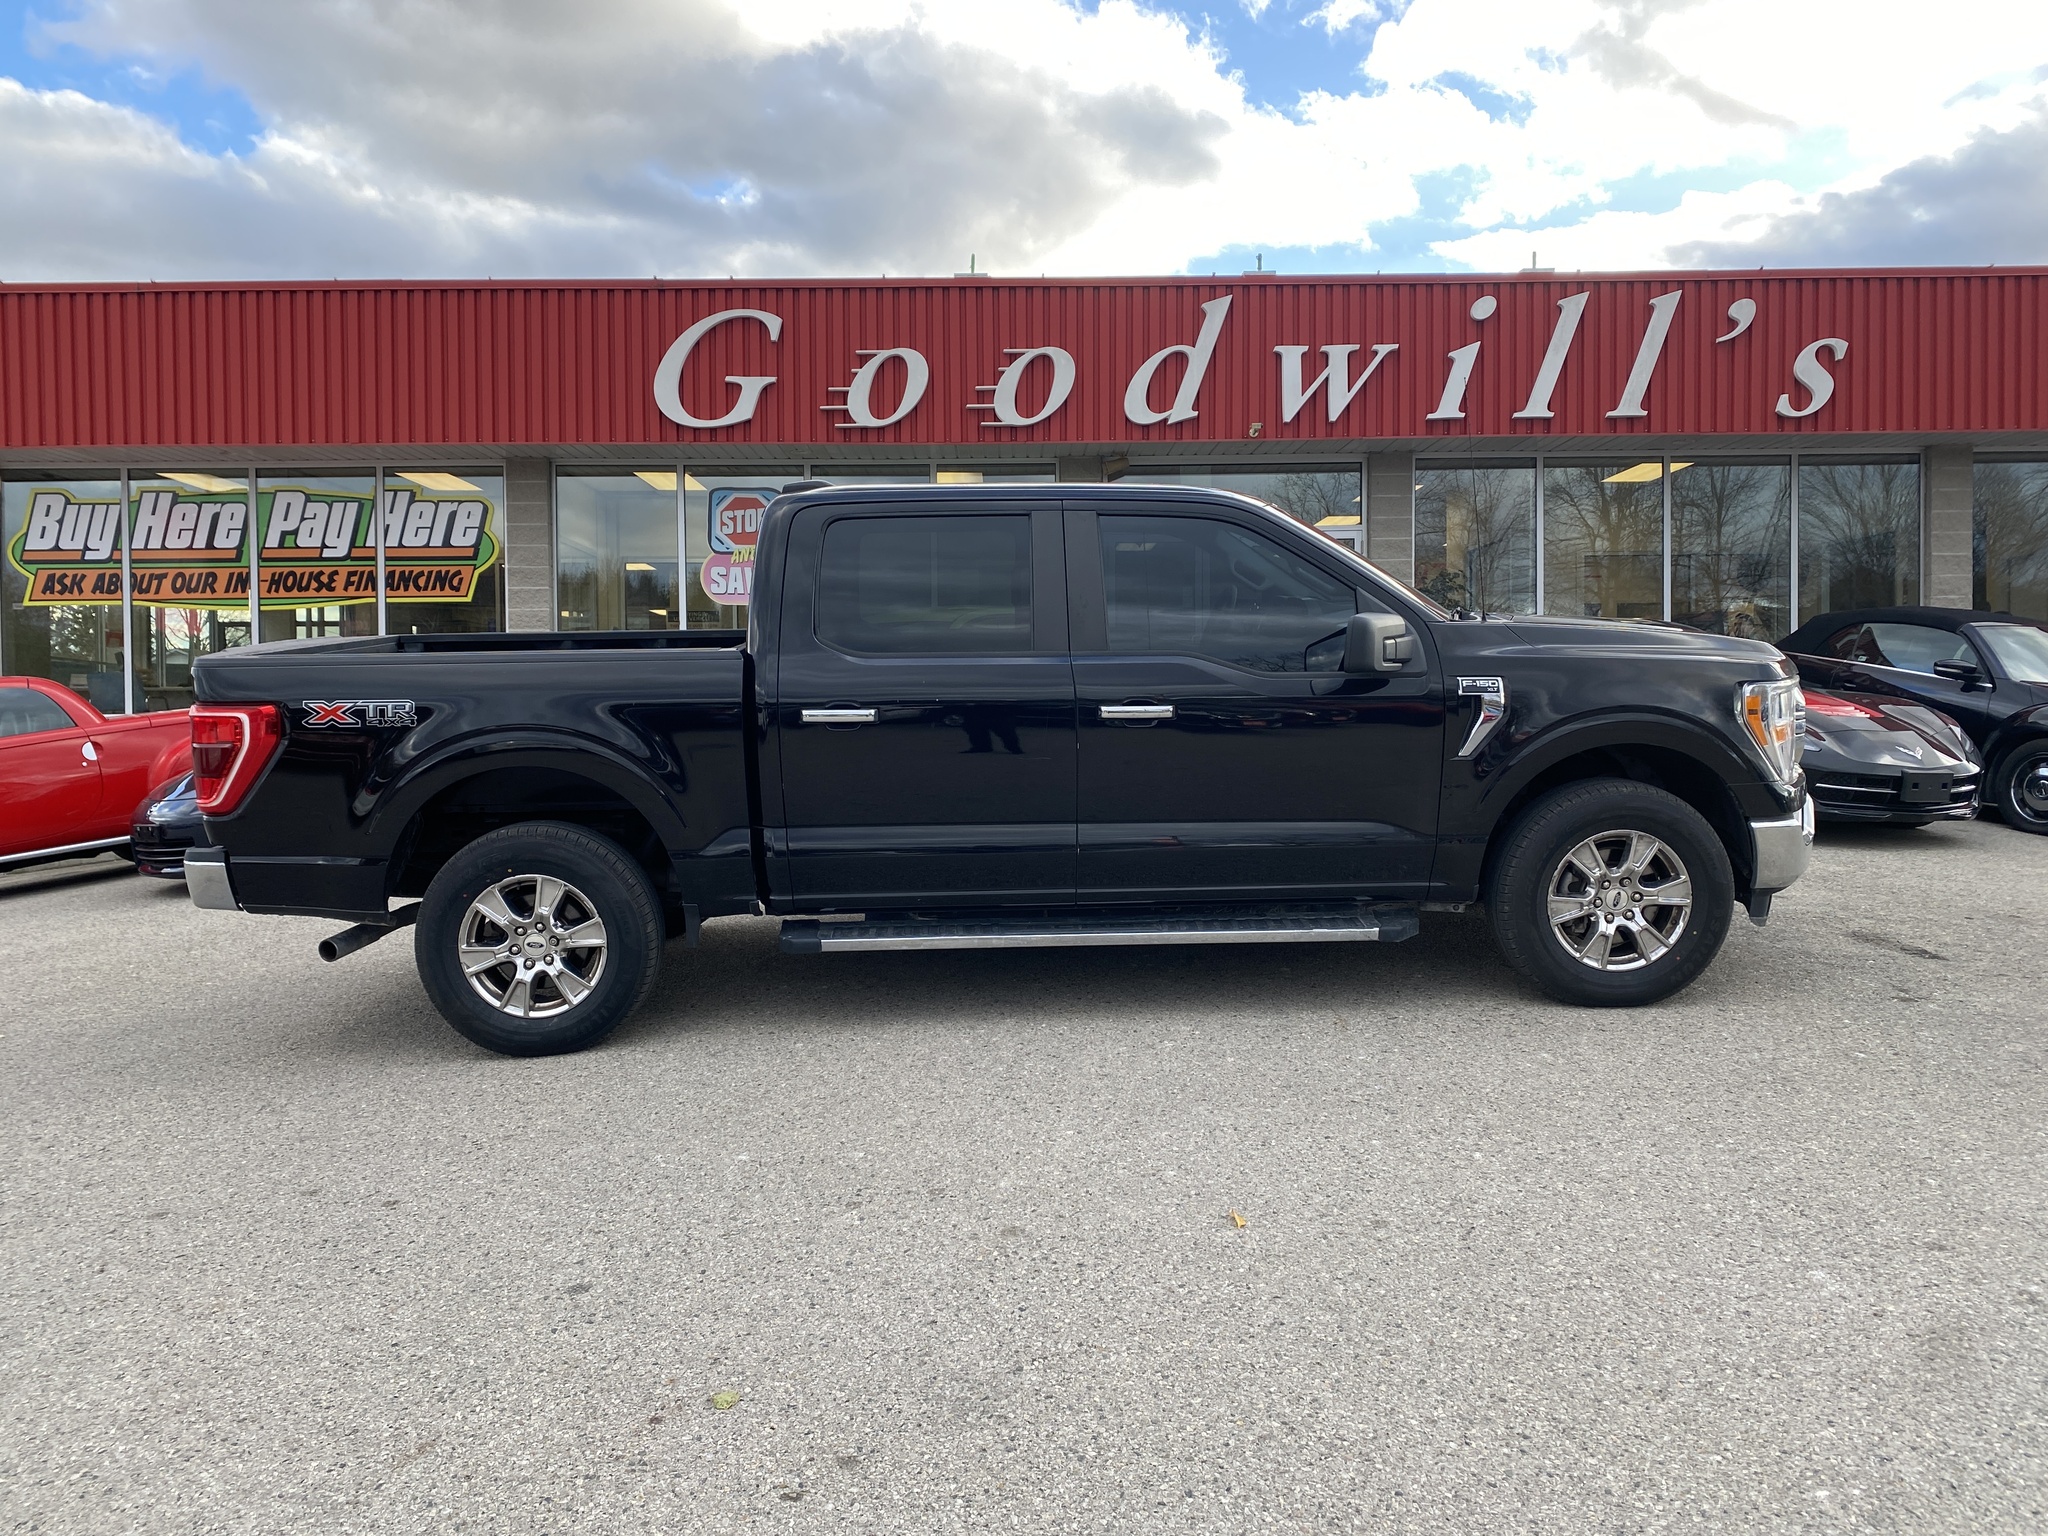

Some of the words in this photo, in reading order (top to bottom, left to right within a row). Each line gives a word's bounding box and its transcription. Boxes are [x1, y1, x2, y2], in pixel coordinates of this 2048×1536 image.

[653, 289, 1849, 429] Goodwill's
[24, 493, 121, 560] Buy
[131, 492, 247, 549] Here
[264, 490, 359, 558] Pay
[365, 490, 484, 547] Here
[41, 572, 88, 595] ASK
[171, 571, 218, 594] OUR
[343, 569, 463, 592] FINANCING
